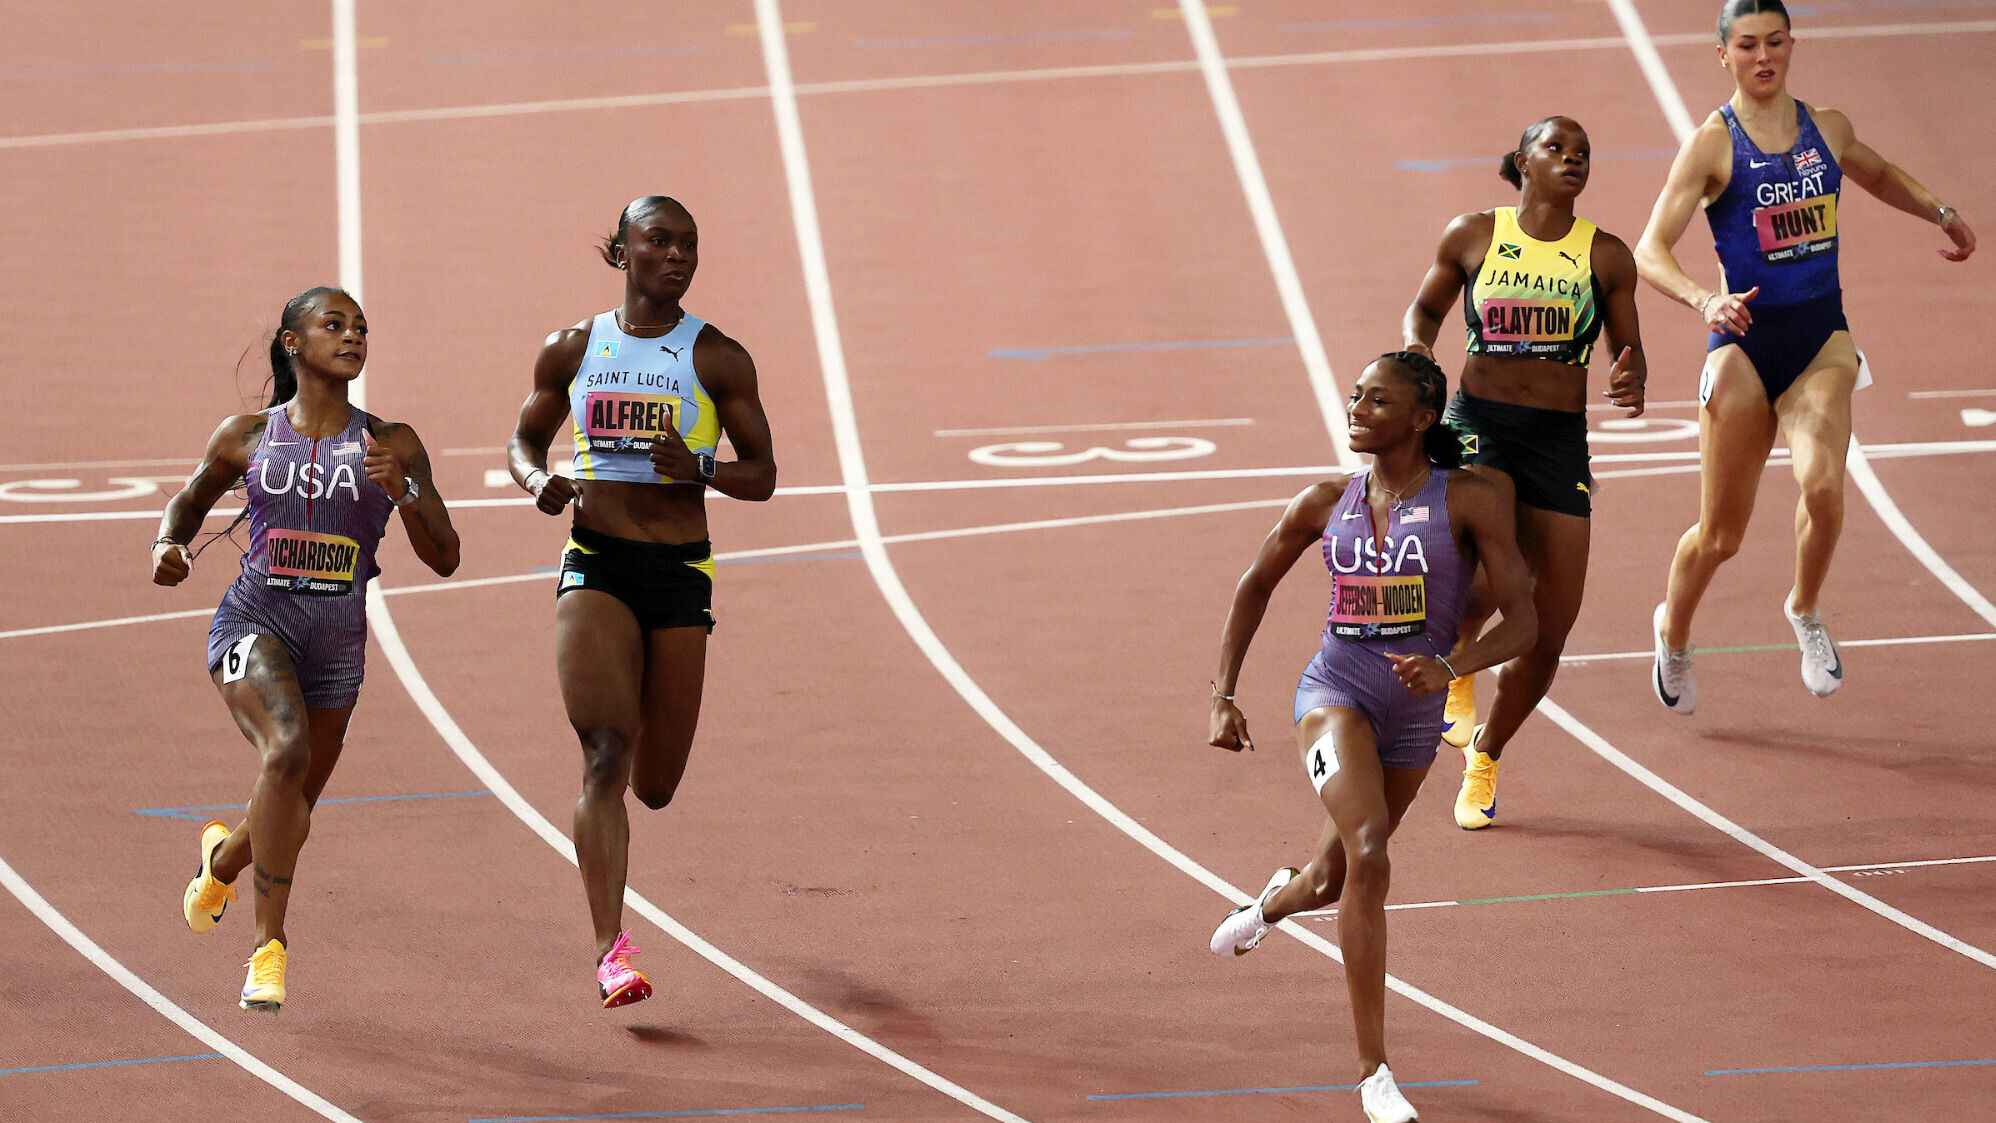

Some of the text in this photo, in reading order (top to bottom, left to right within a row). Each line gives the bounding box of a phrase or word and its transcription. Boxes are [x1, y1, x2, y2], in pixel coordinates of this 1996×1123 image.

[1756, 171, 1824, 207] GREAT
[1771, 204, 1826, 241] HUNT
[1485, 269, 1581, 300] JAMAICA
[1488, 306, 1570, 335] CLAYTON
[587, 371, 680, 394] SAINT LUCIA
[591, 399, 674, 432] ALFRED
[260, 457, 360, 502] USA
[268, 537, 355, 573] RICHARDSON
[1331, 534, 1429, 574] USA
[1336, 583, 1423, 616] JEFFERSON-WOODEN
[228, 640, 242, 675] 6
[1313, 747, 1327, 779] 4
